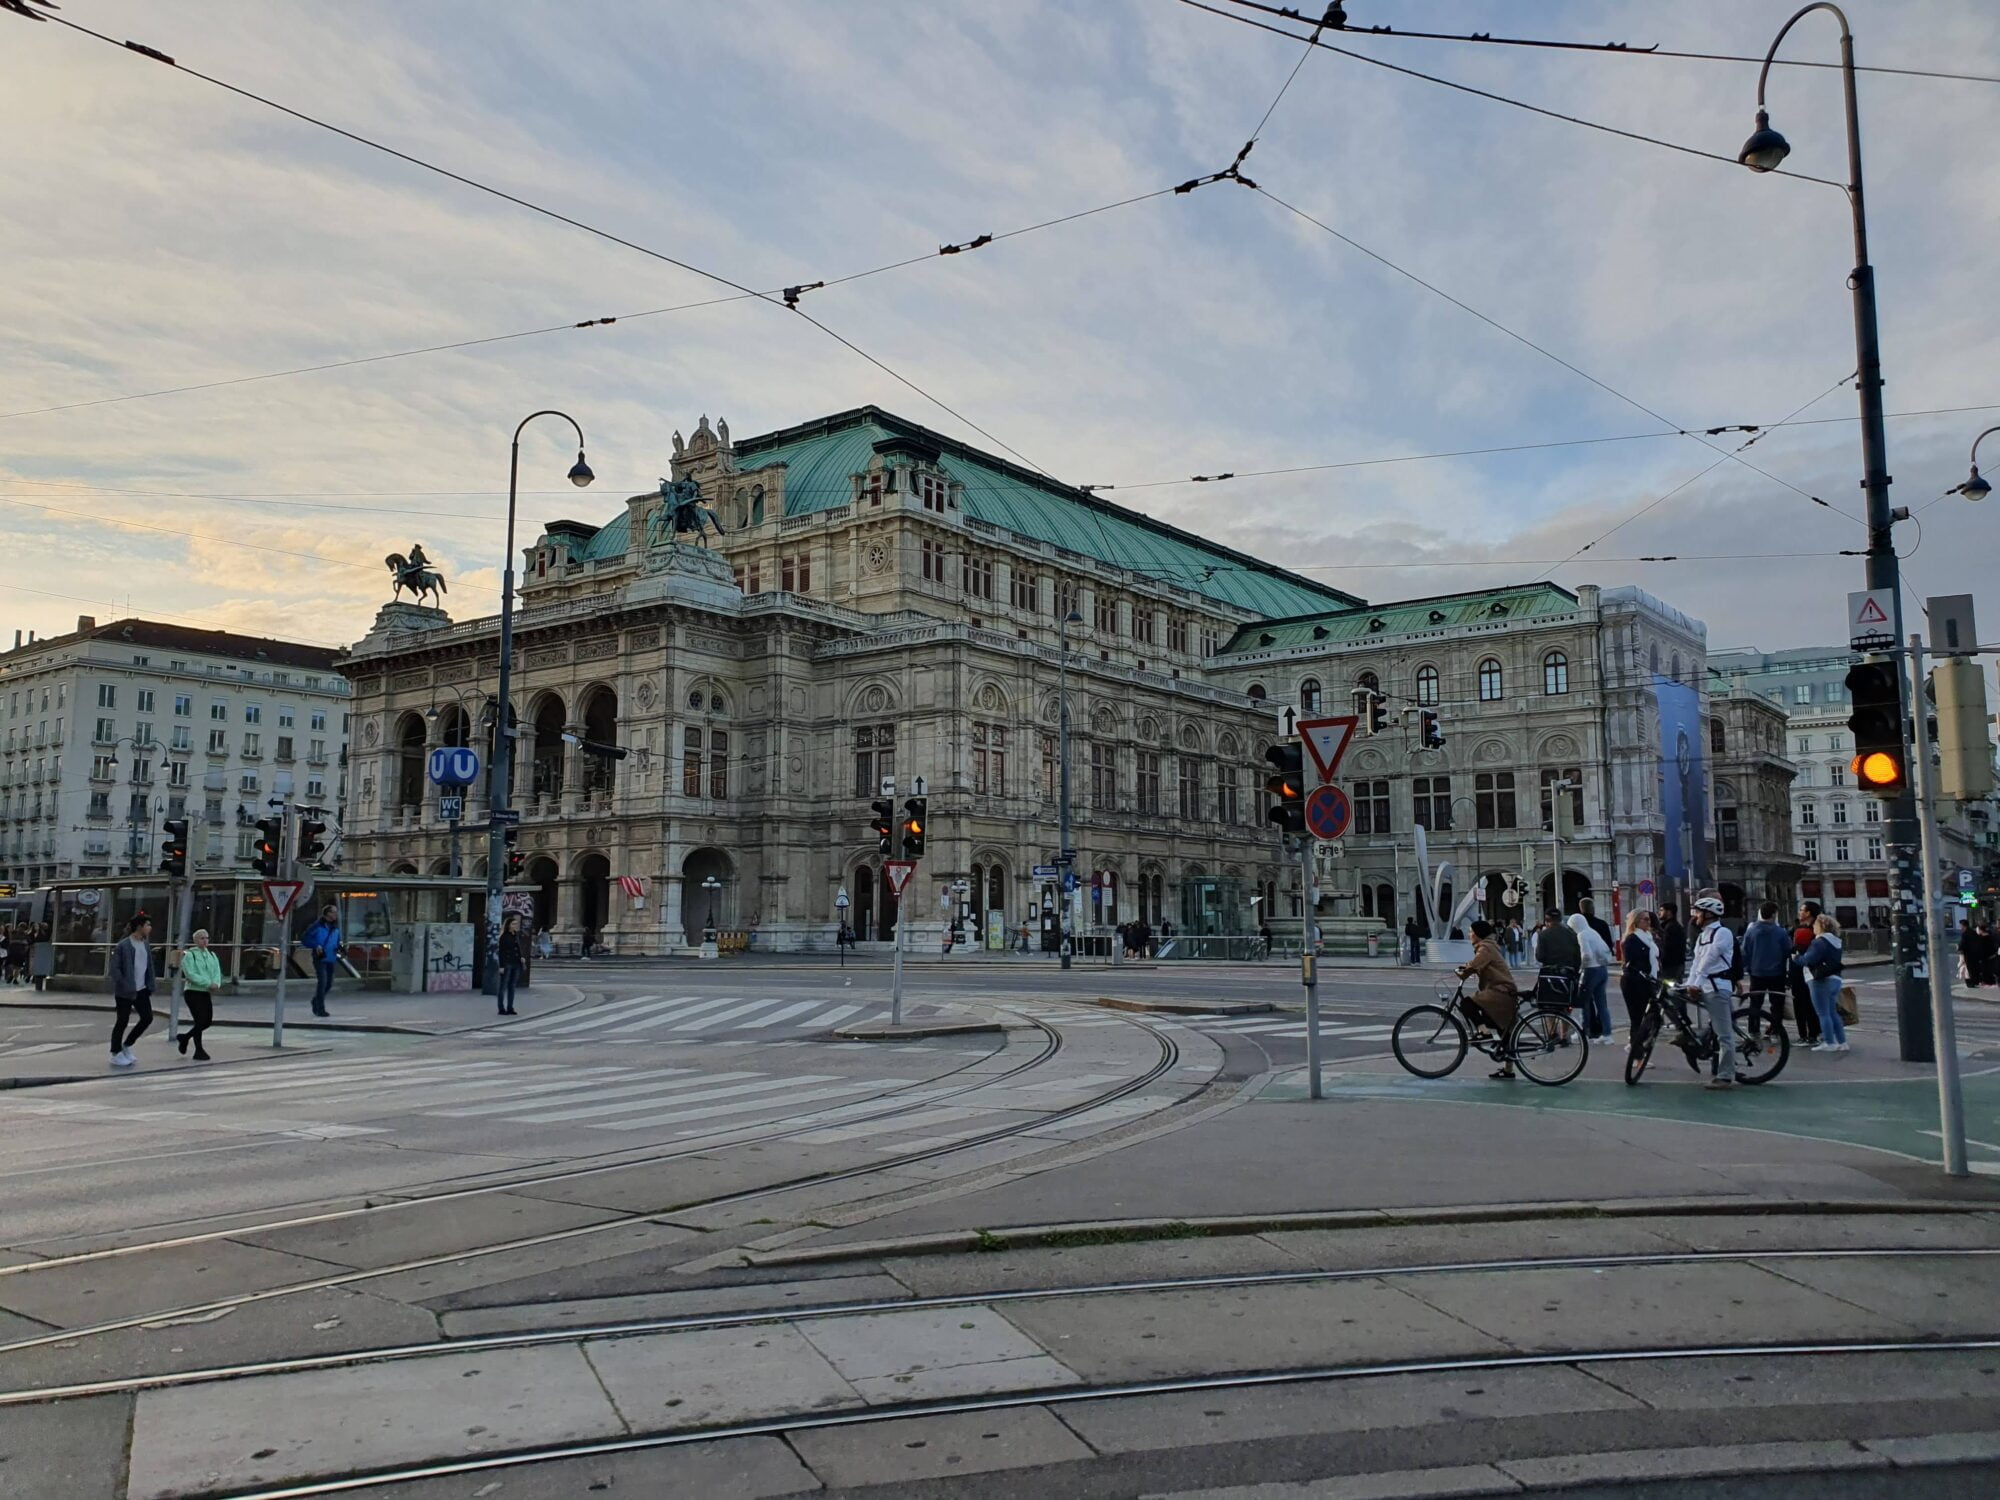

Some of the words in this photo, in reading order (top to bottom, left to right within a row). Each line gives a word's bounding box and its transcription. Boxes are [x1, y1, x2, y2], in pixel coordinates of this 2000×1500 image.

[431, 754, 444, 779] U
[454, 754, 475, 779] U
[442, 799, 459, 809] WC
